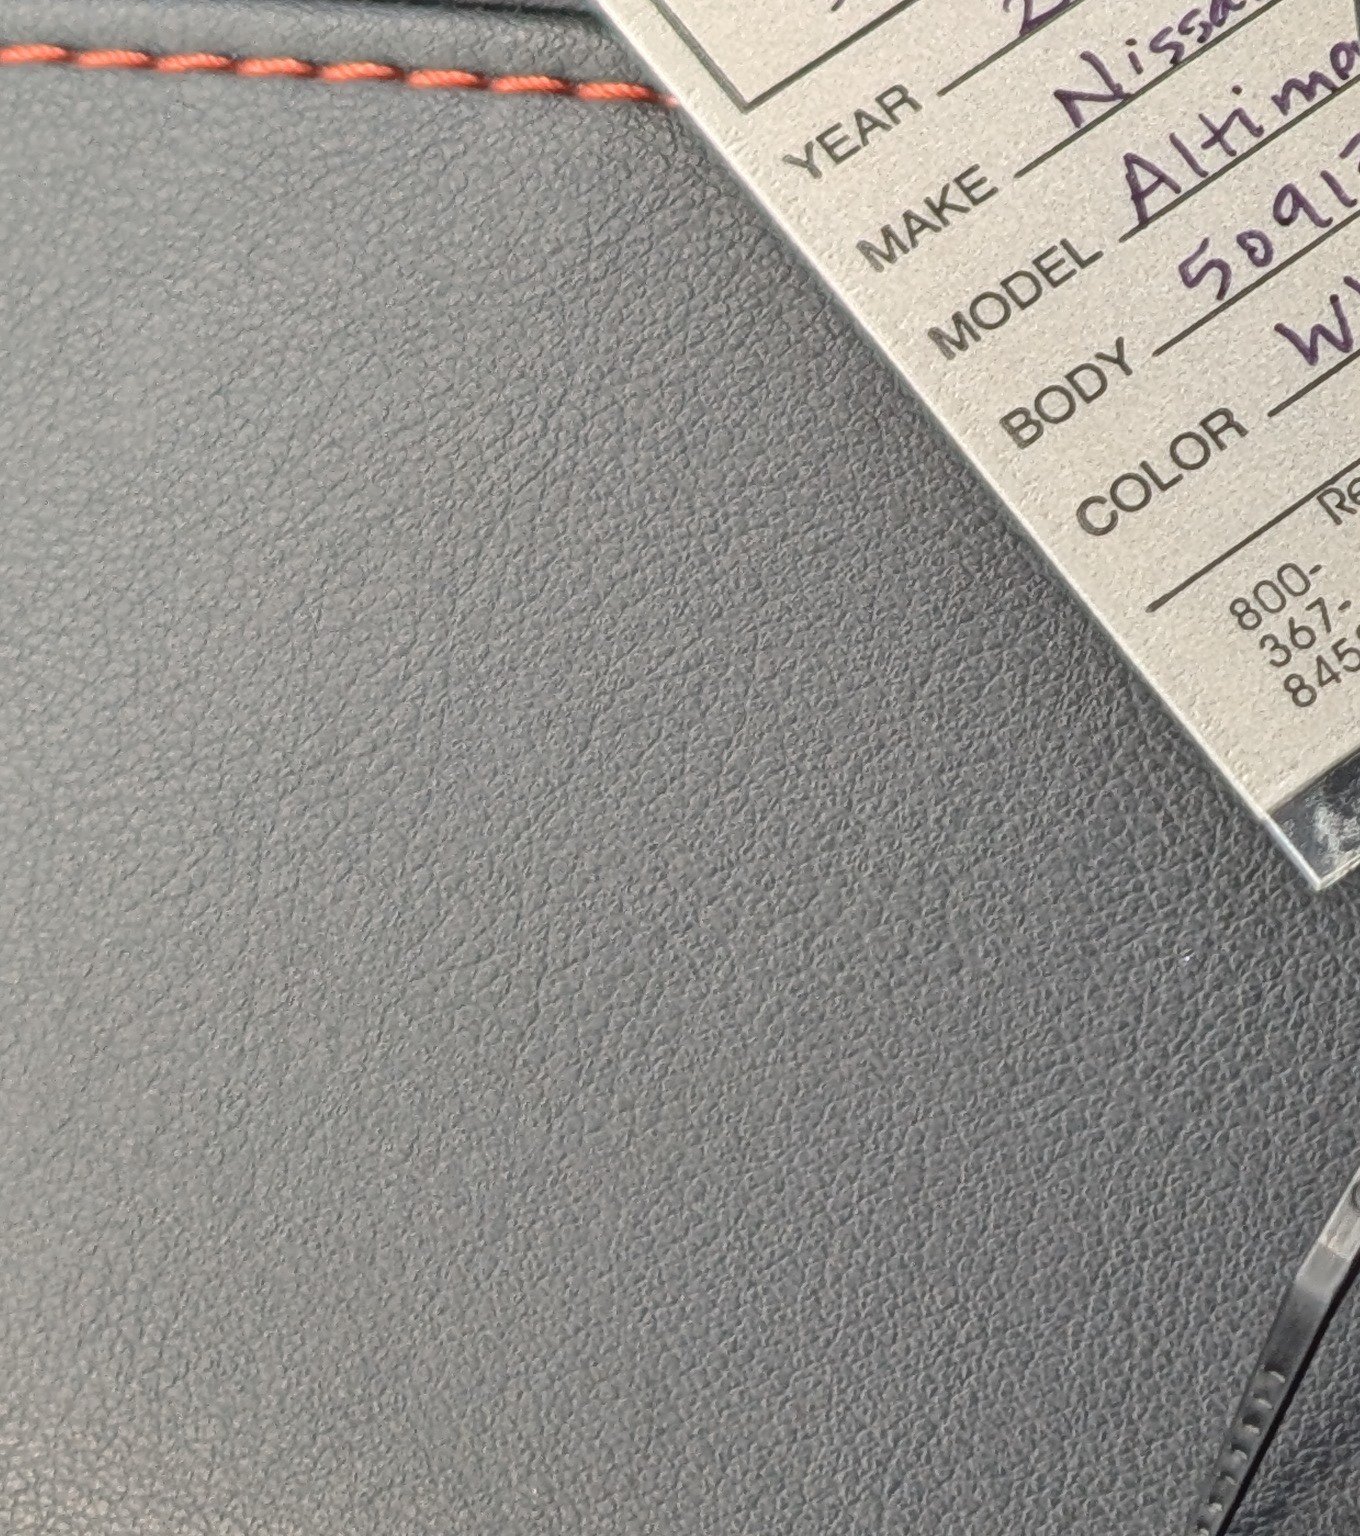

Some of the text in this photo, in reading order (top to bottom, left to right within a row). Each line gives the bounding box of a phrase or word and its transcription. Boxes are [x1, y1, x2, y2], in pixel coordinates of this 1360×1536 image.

[783, 84, 923, 181] YEAR
[856, 163, 999, 273] MAKE
[927, 236, 1103, 361] MODEL
[998, 335, 1142, 451] BODY
[1075, 406, 1250, 537] COLOR
[1228, 561, 1324, 632] 800-
[1258, 596, 1353, 669] 367-
